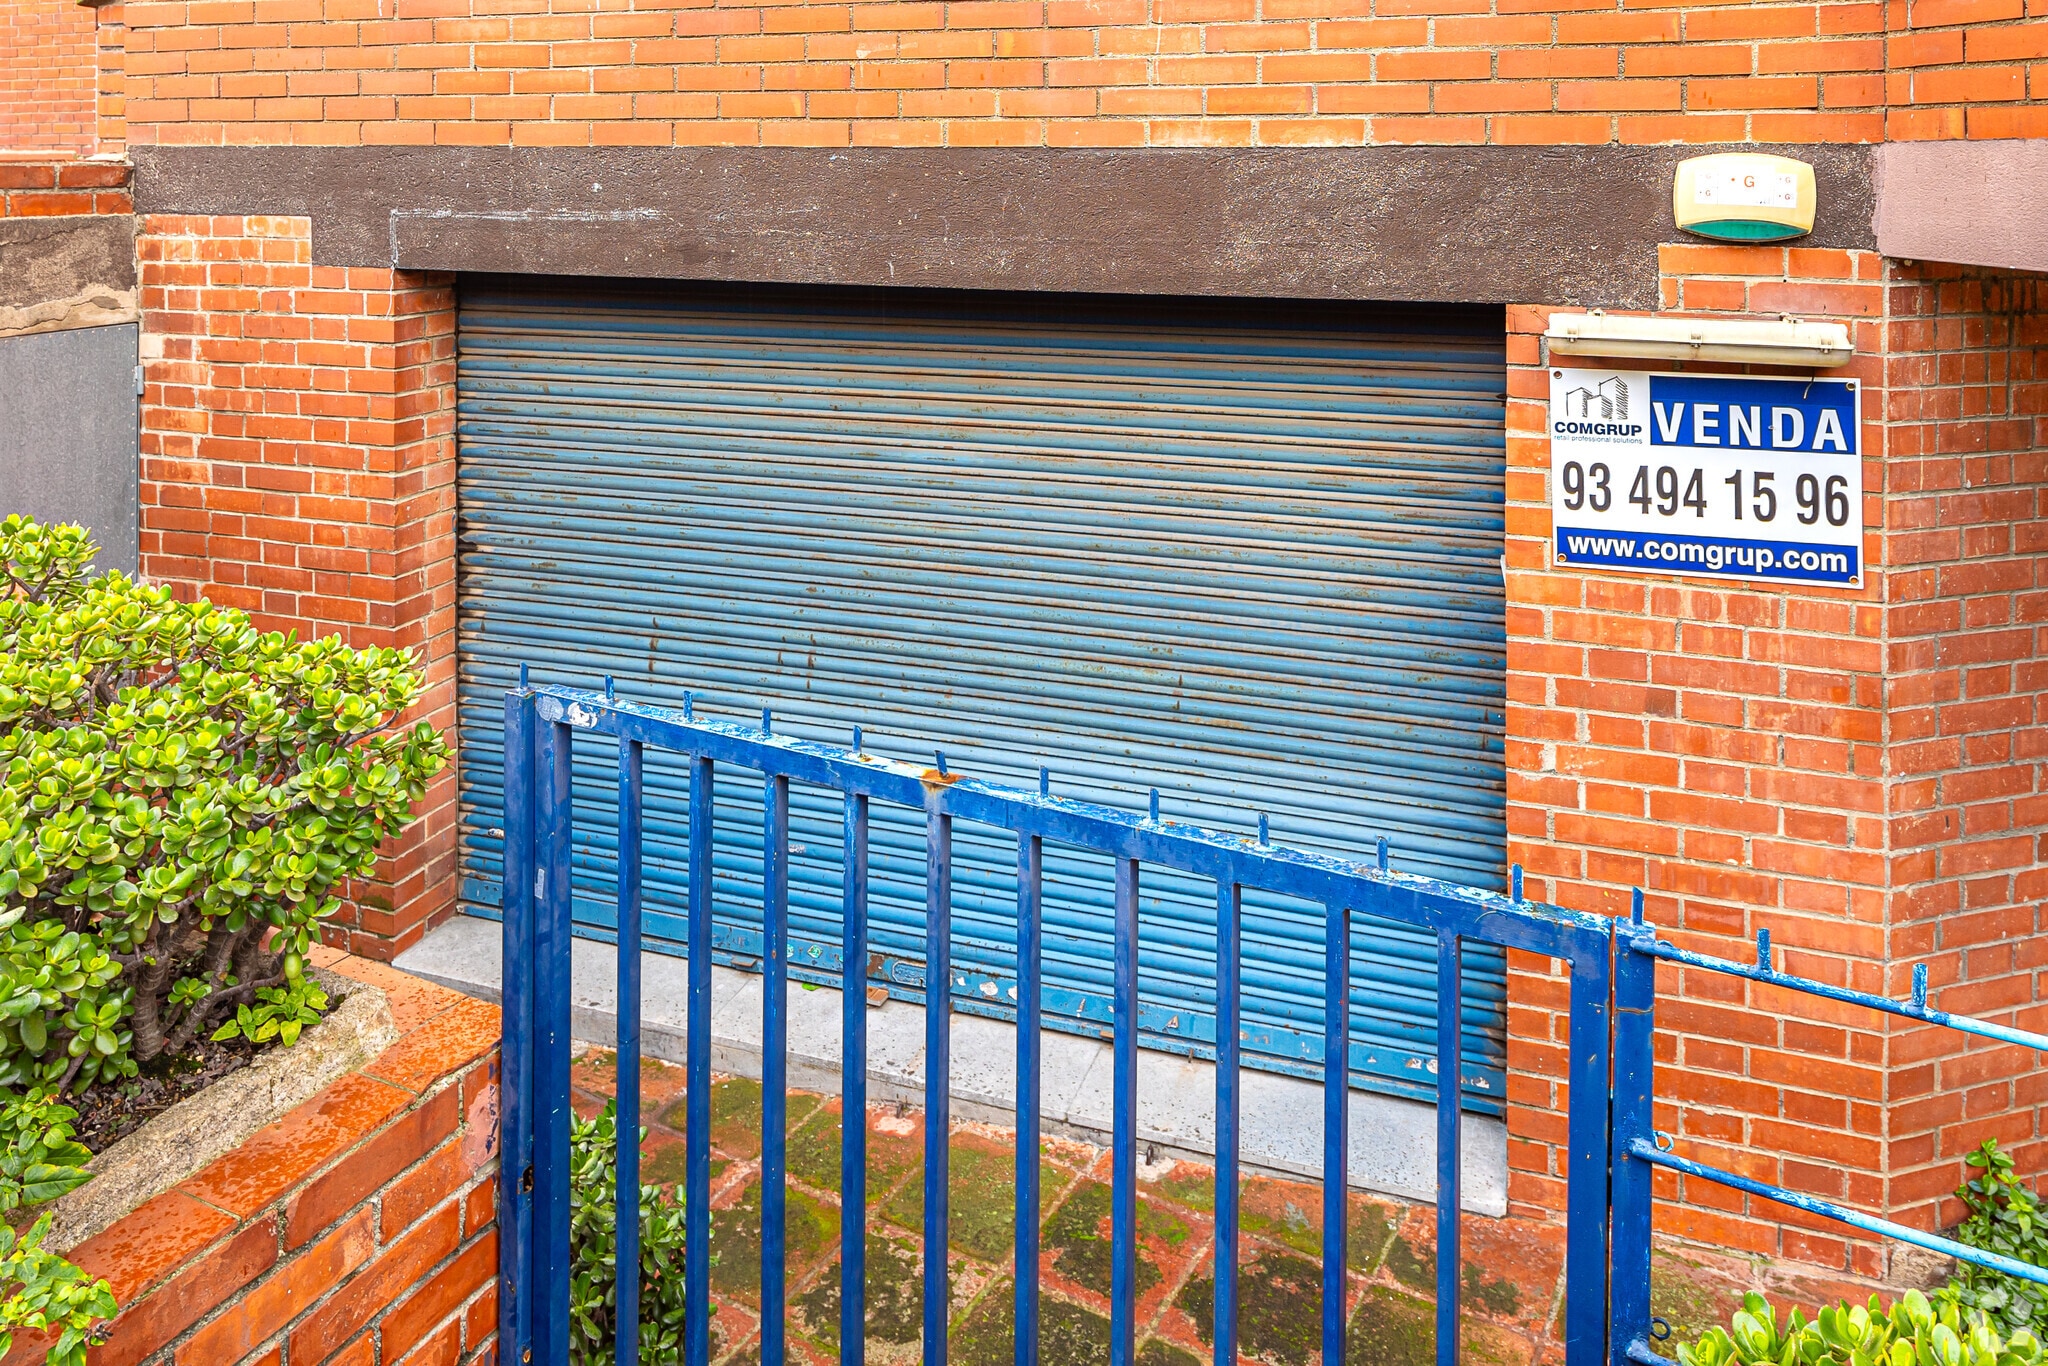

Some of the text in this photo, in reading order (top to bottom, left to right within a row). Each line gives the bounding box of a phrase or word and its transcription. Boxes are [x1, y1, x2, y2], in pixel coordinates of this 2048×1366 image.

[1743, 175, 1755, 188] G
[1554, 421, 1643, 436] COMGRUP
[1571, 435, 1611, 443] professional
[1652, 401, 1848, 451] VENDA
[1562, 461, 1850, 527] 93 494 15 96
[1567, 535, 1848, 573] www.comgrup.com
